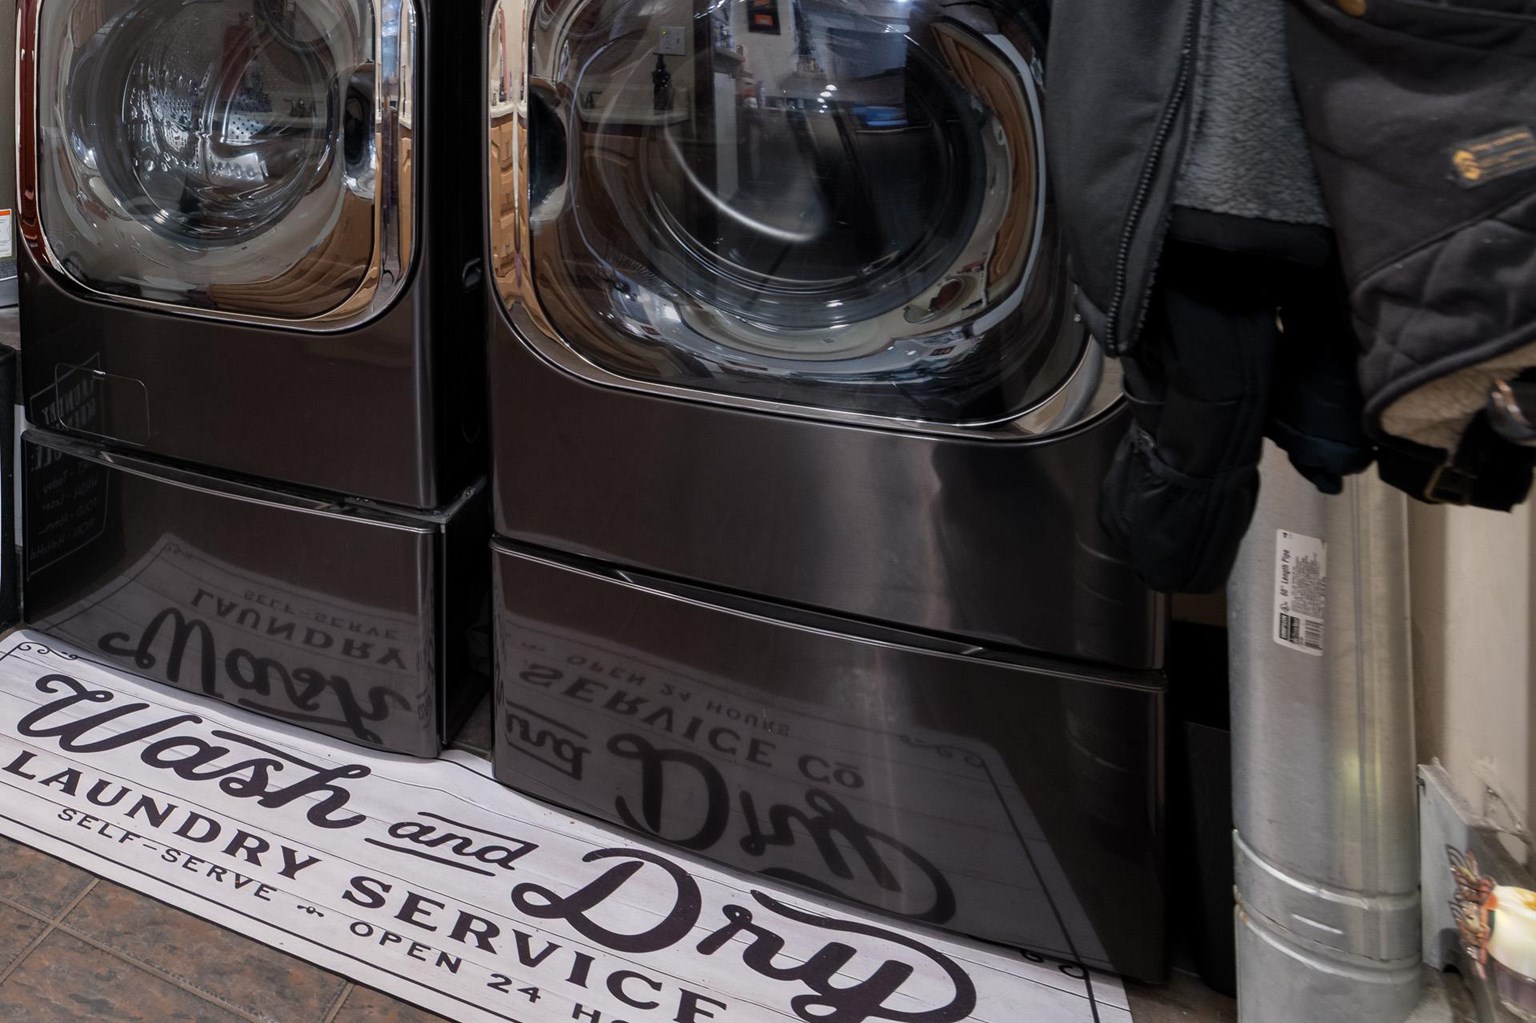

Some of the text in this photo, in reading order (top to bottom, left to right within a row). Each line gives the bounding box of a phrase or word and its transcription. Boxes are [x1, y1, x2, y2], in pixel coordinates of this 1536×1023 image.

[1280, 564, 1290, 584] Length
[1281, 549, 1292, 564] Pipe
[1, 749, 729, 1023] LAUNDRY SERVICE
[16, 673, 977, 1023] Wash and Dry
[57, 806, 542, 1004] SELF-SERVE OPEN 24
